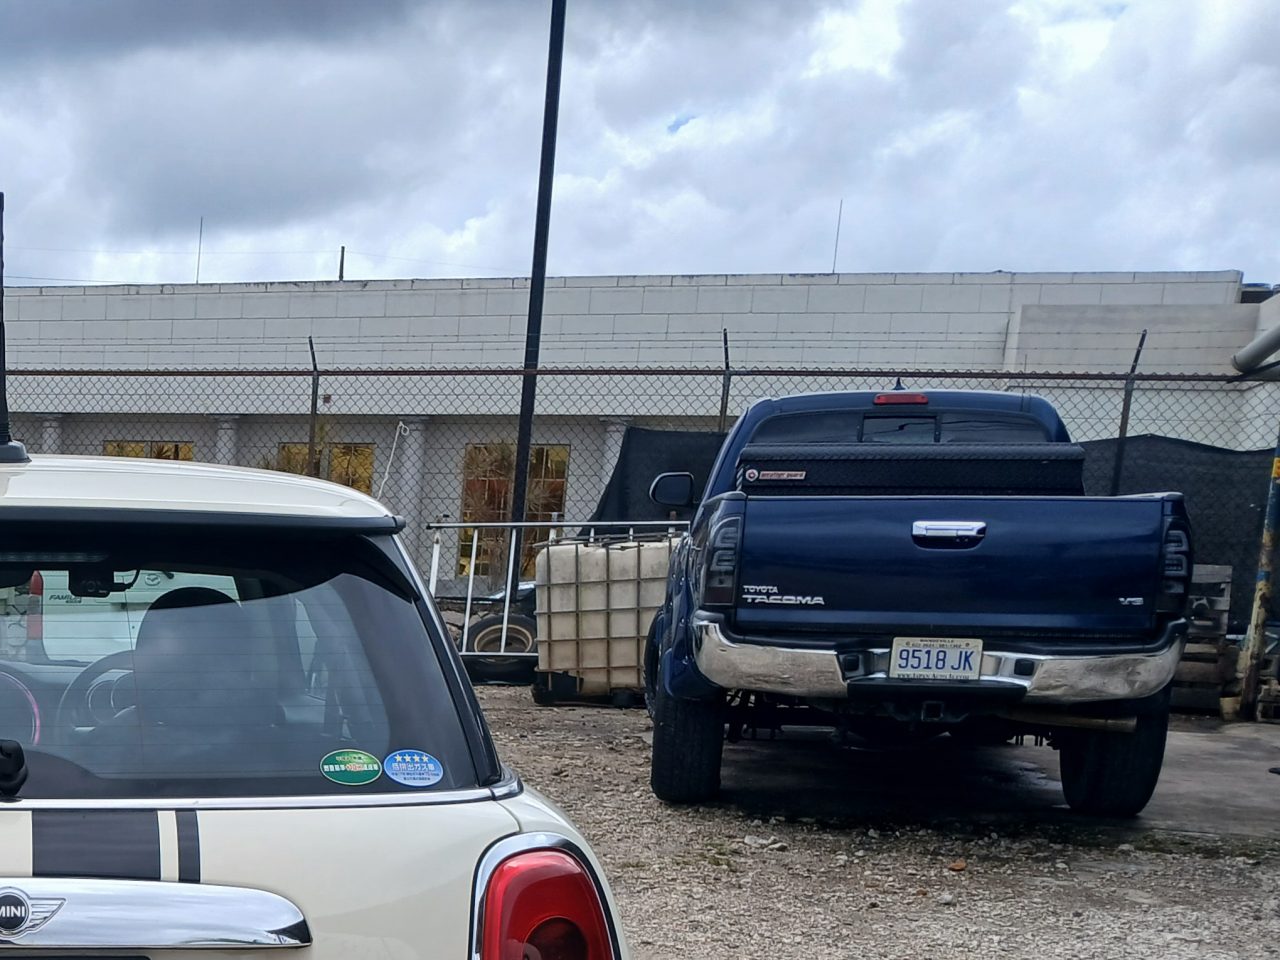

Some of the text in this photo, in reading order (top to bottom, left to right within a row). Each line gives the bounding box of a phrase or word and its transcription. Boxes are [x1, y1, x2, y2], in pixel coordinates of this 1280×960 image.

[743, 585, 778, 593] TOYOTA
[742, 595, 825, 605] TACOMA
[898, 649, 975, 671] 9518 JK
